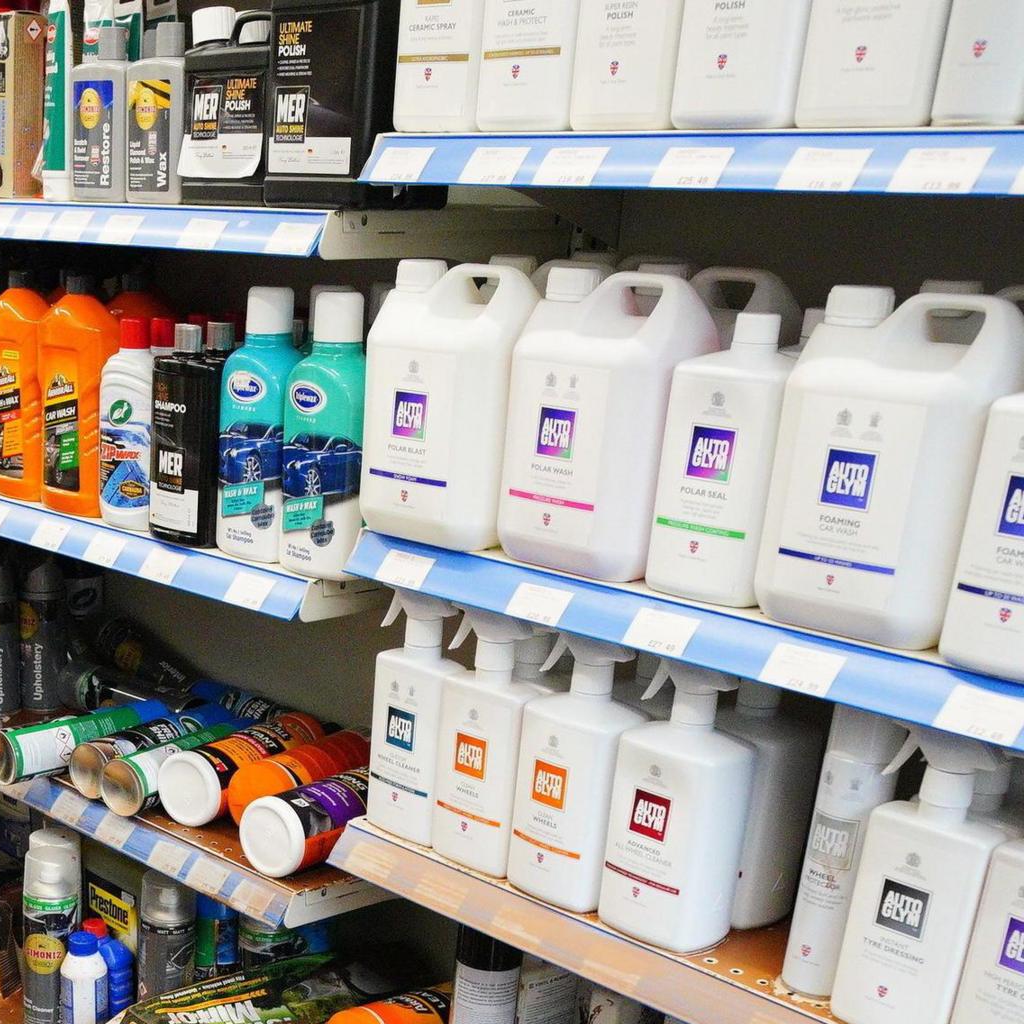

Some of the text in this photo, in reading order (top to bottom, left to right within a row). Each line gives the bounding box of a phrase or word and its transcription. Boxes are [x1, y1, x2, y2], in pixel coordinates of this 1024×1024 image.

[714, 0, 745, 10] POLISH
[507, 8, 536, 17] CERAMIC
[606, 11, 634, 20] POLISH
[279, 21, 313, 34] ULTIMATE
[408, 22, 456, 32] CERAMIC SPRAY
[279, 33, 300, 45] SHINE
[278, 45, 306, 56] POLISH
[227, 78, 257, 89] ULTIMATE
[226, 89, 245, 100] SHINE
[194, 93, 219, 120] MER
[225, 100, 250, 111] POLISH
[276, 94, 305, 122] MER
[100, 122, 110, 186] Restore
[157, 152, 167, 187] Wax
[45, 406, 76, 422] CAR WASH
[154, 400, 187, 414] SHAMPOO
[387, 443, 427, 456] POLAR BLAST
[158, 449, 183, 478] MER
[531, 463, 573, 477] POLAR WASH
[680, 486, 728, 501] POLAR SEAL
[819, 514, 860, 529] FOAMING
[33, 643, 44, 701] Upholstery
[456, 786, 479, 799] WHEELS
[533, 816, 558, 829] WHEELS
[627, 839, 661, 856] ADVANCED
[809, 869, 836, 883] WHEEL
[90, 884, 129, 926] Prestone
[863, 936, 925, 966] TYRE DRESSING
[996, 983, 1018, 997] TYRE
